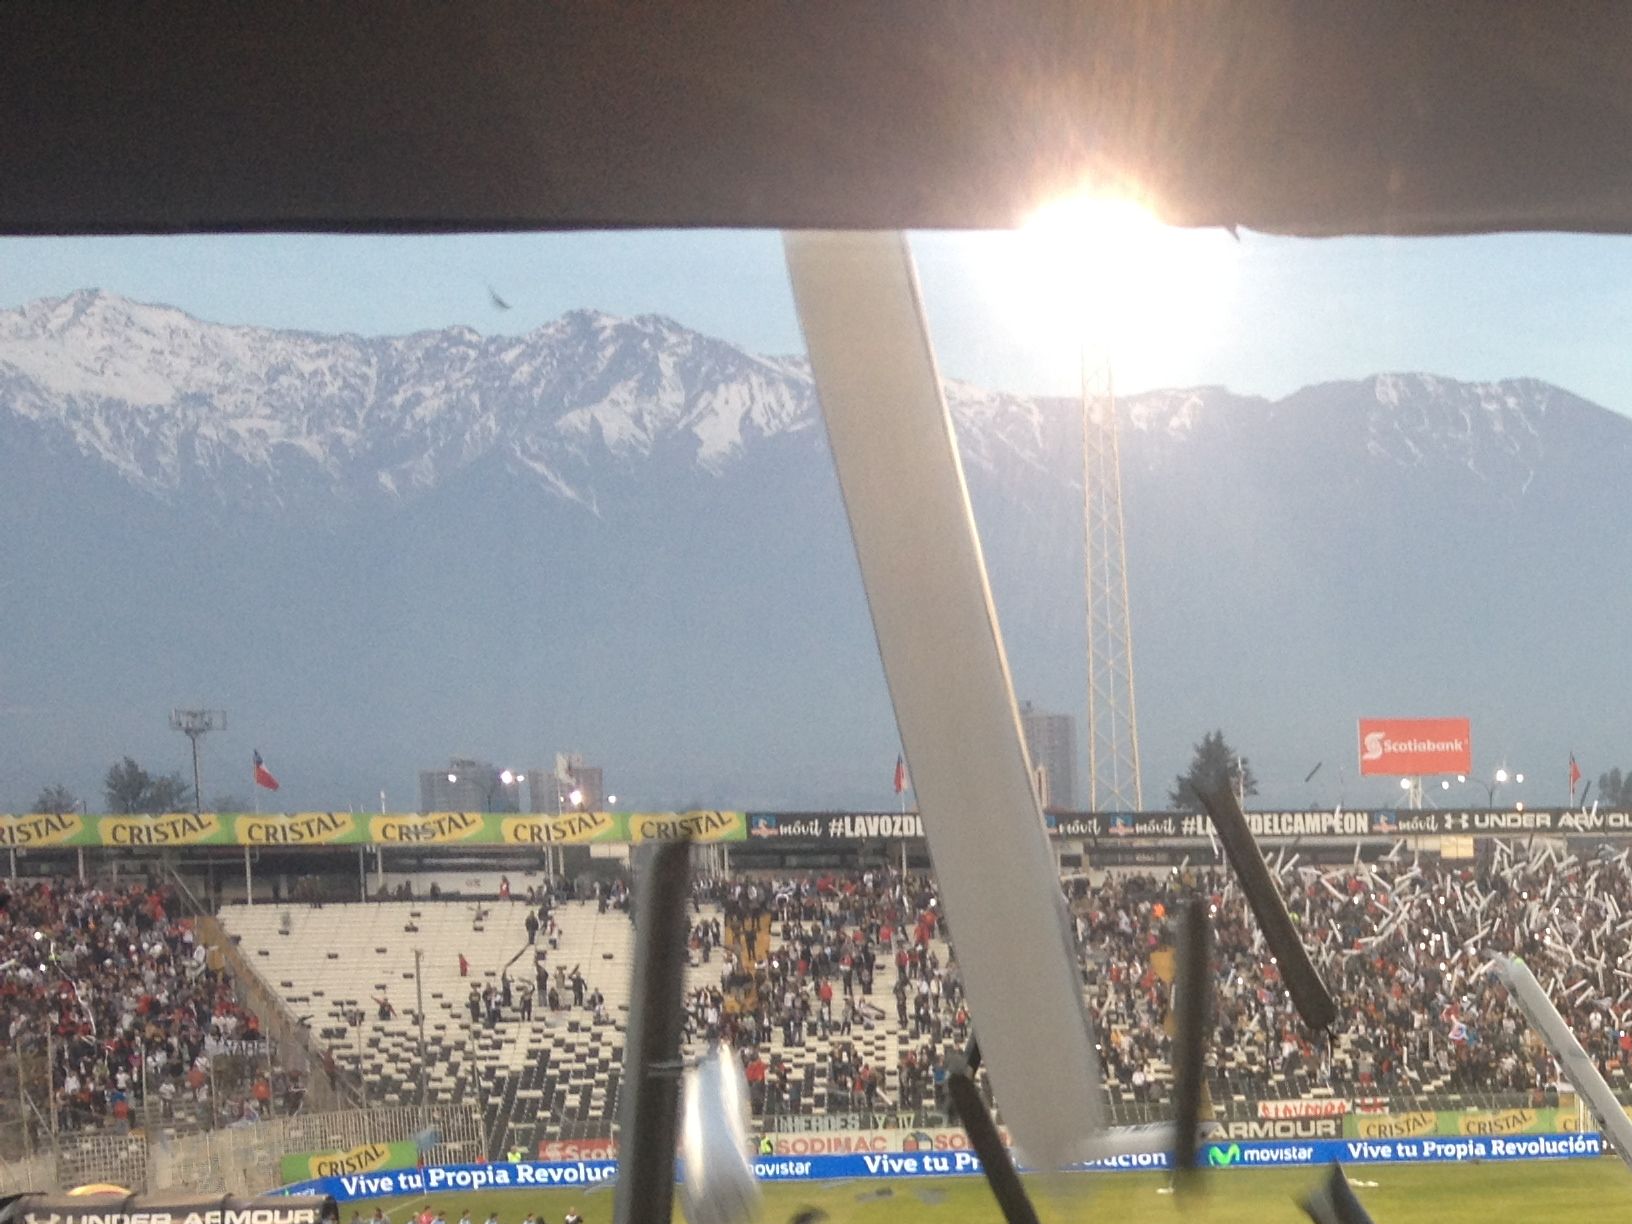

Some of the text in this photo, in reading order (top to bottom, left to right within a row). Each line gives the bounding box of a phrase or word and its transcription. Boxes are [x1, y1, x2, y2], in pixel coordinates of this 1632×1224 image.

[1383, 738, 1464, 753] Scotiabank
[0, 814, 74, 846] RISTAL
[111, 813, 212, 845] CRISTAL
[247, 812, 347, 843] CRISTAL
[381, 812, 477, 842] CRISTAL
[513, 811, 605, 842] CRISTAL
[641, 811, 733, 840] CRISTAL
[1474, 814, 1551, 829] UNDER
[1207, 1120, 1337, 1139] ARMOUR
[1367, 1113, 1433, 1138] CRISTAL
[1466, 1110, 1533, 1135] CRISTAL
[779, 1136, 888, 1155] SODIMAC
[1244, 1146, 1313, 1161] movistar
[1347, 1142, 1391, 1159] Vive
[1396, 1142, 1417, 1158] tu
[1423, 1140, 1485, 1161] Propia
[1491, 1135, 1599, 1157] Revolución
[318, 1144, 386, 1179] CRISTAL
[752, 1161, 811, 1177] ovistar
[864, 1155, 917, 1174] Vive
[923, 1153, 948, 1172] tu
[341, 1175, 390, 1196] Vive
[398, 1171, 422, 1190] tu
[428, 1166, 511, 1192] Propia
[517, 1161, 618, 1184] Revoluc
